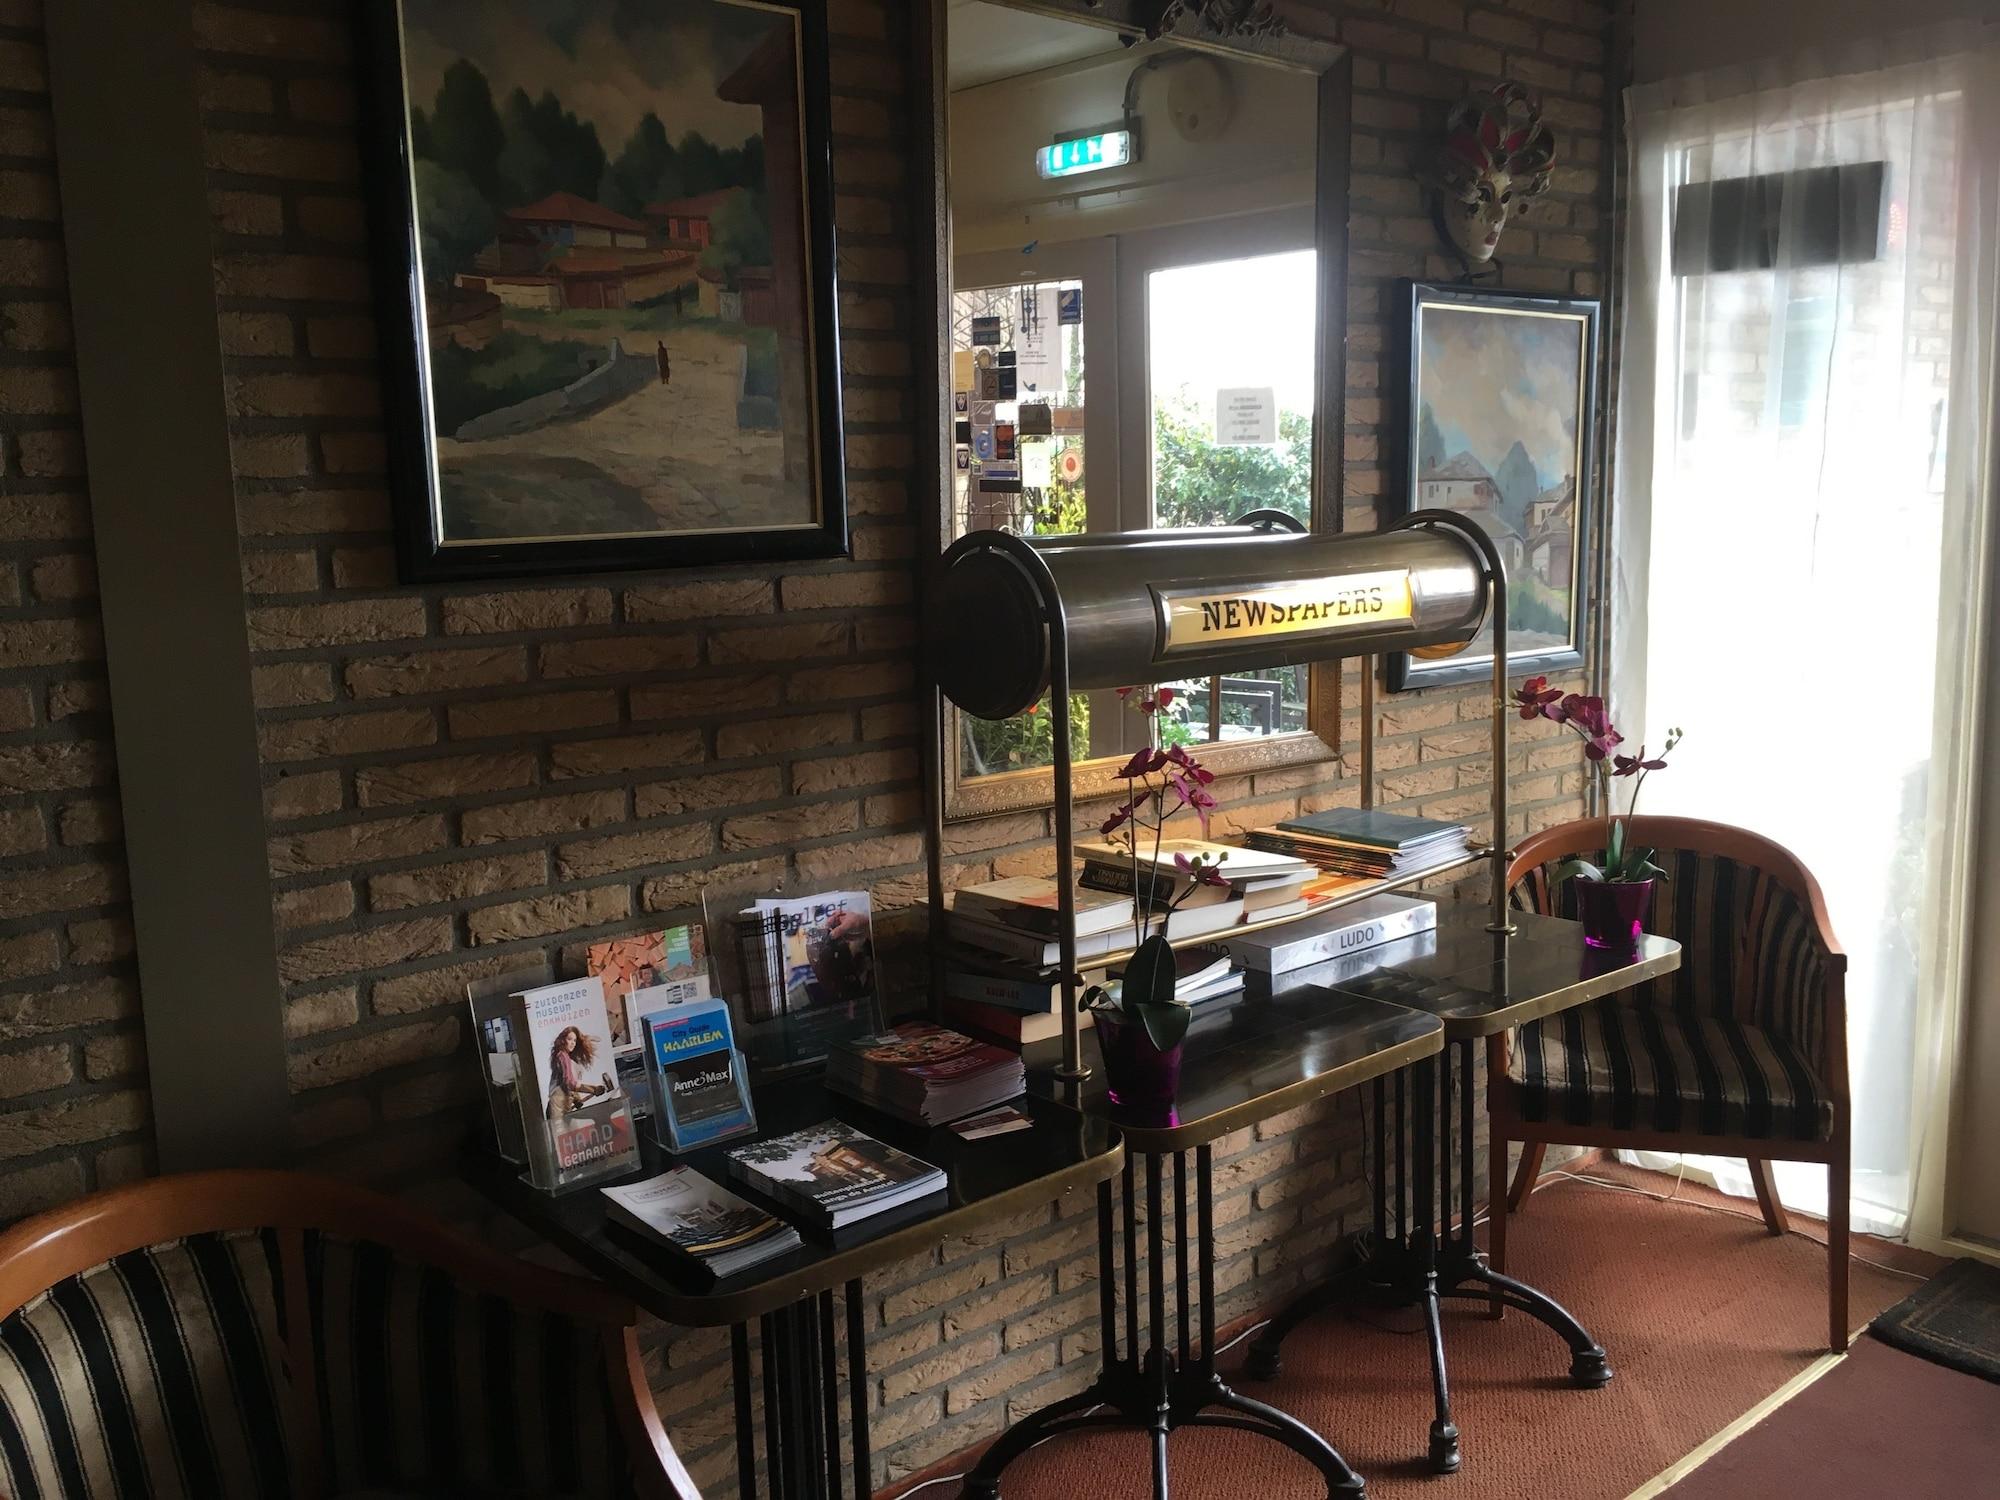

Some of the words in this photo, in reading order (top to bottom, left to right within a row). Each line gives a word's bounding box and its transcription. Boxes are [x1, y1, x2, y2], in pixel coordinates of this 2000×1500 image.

[1201, 587, 1384, 631] NEWSPAPERS
[1340, 927, 1374, 949] LUDO
[663, 1030, 724, 1053] HAARLEM
[672, 1029, 688, 1038] City
[562, 1124, 613, 1153] HAND
